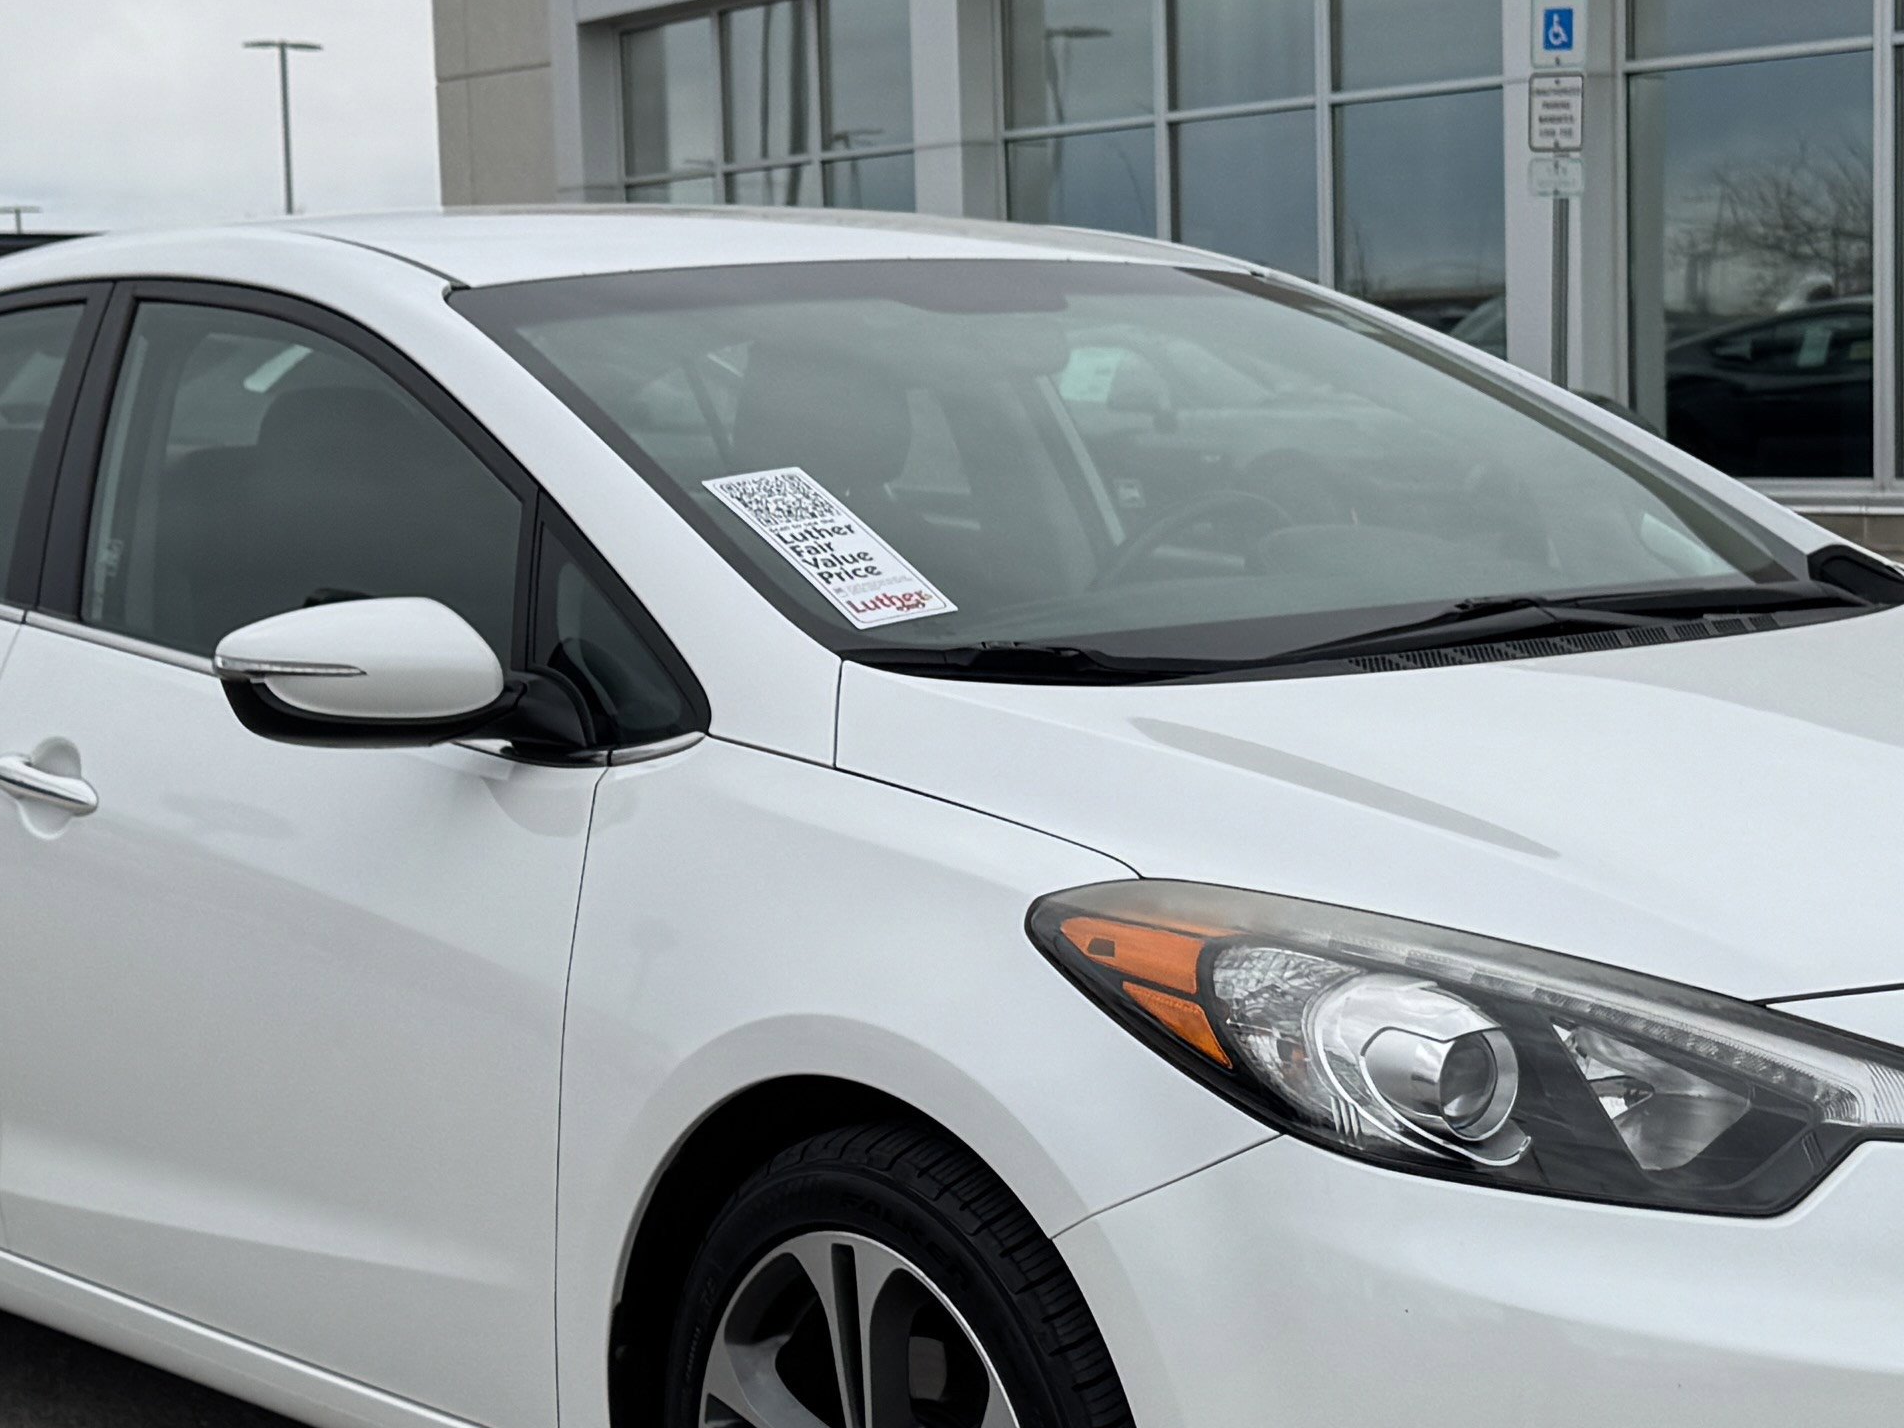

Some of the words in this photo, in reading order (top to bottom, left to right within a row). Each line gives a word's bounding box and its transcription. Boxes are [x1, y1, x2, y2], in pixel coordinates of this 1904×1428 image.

[776, 525, 855, 545] Luther
[789, 541, 834, 557] Fair
[802, 551, 874, 569] Value
[817, 565, 882, 584] Price
[846, 588, 926, 614] Luther
